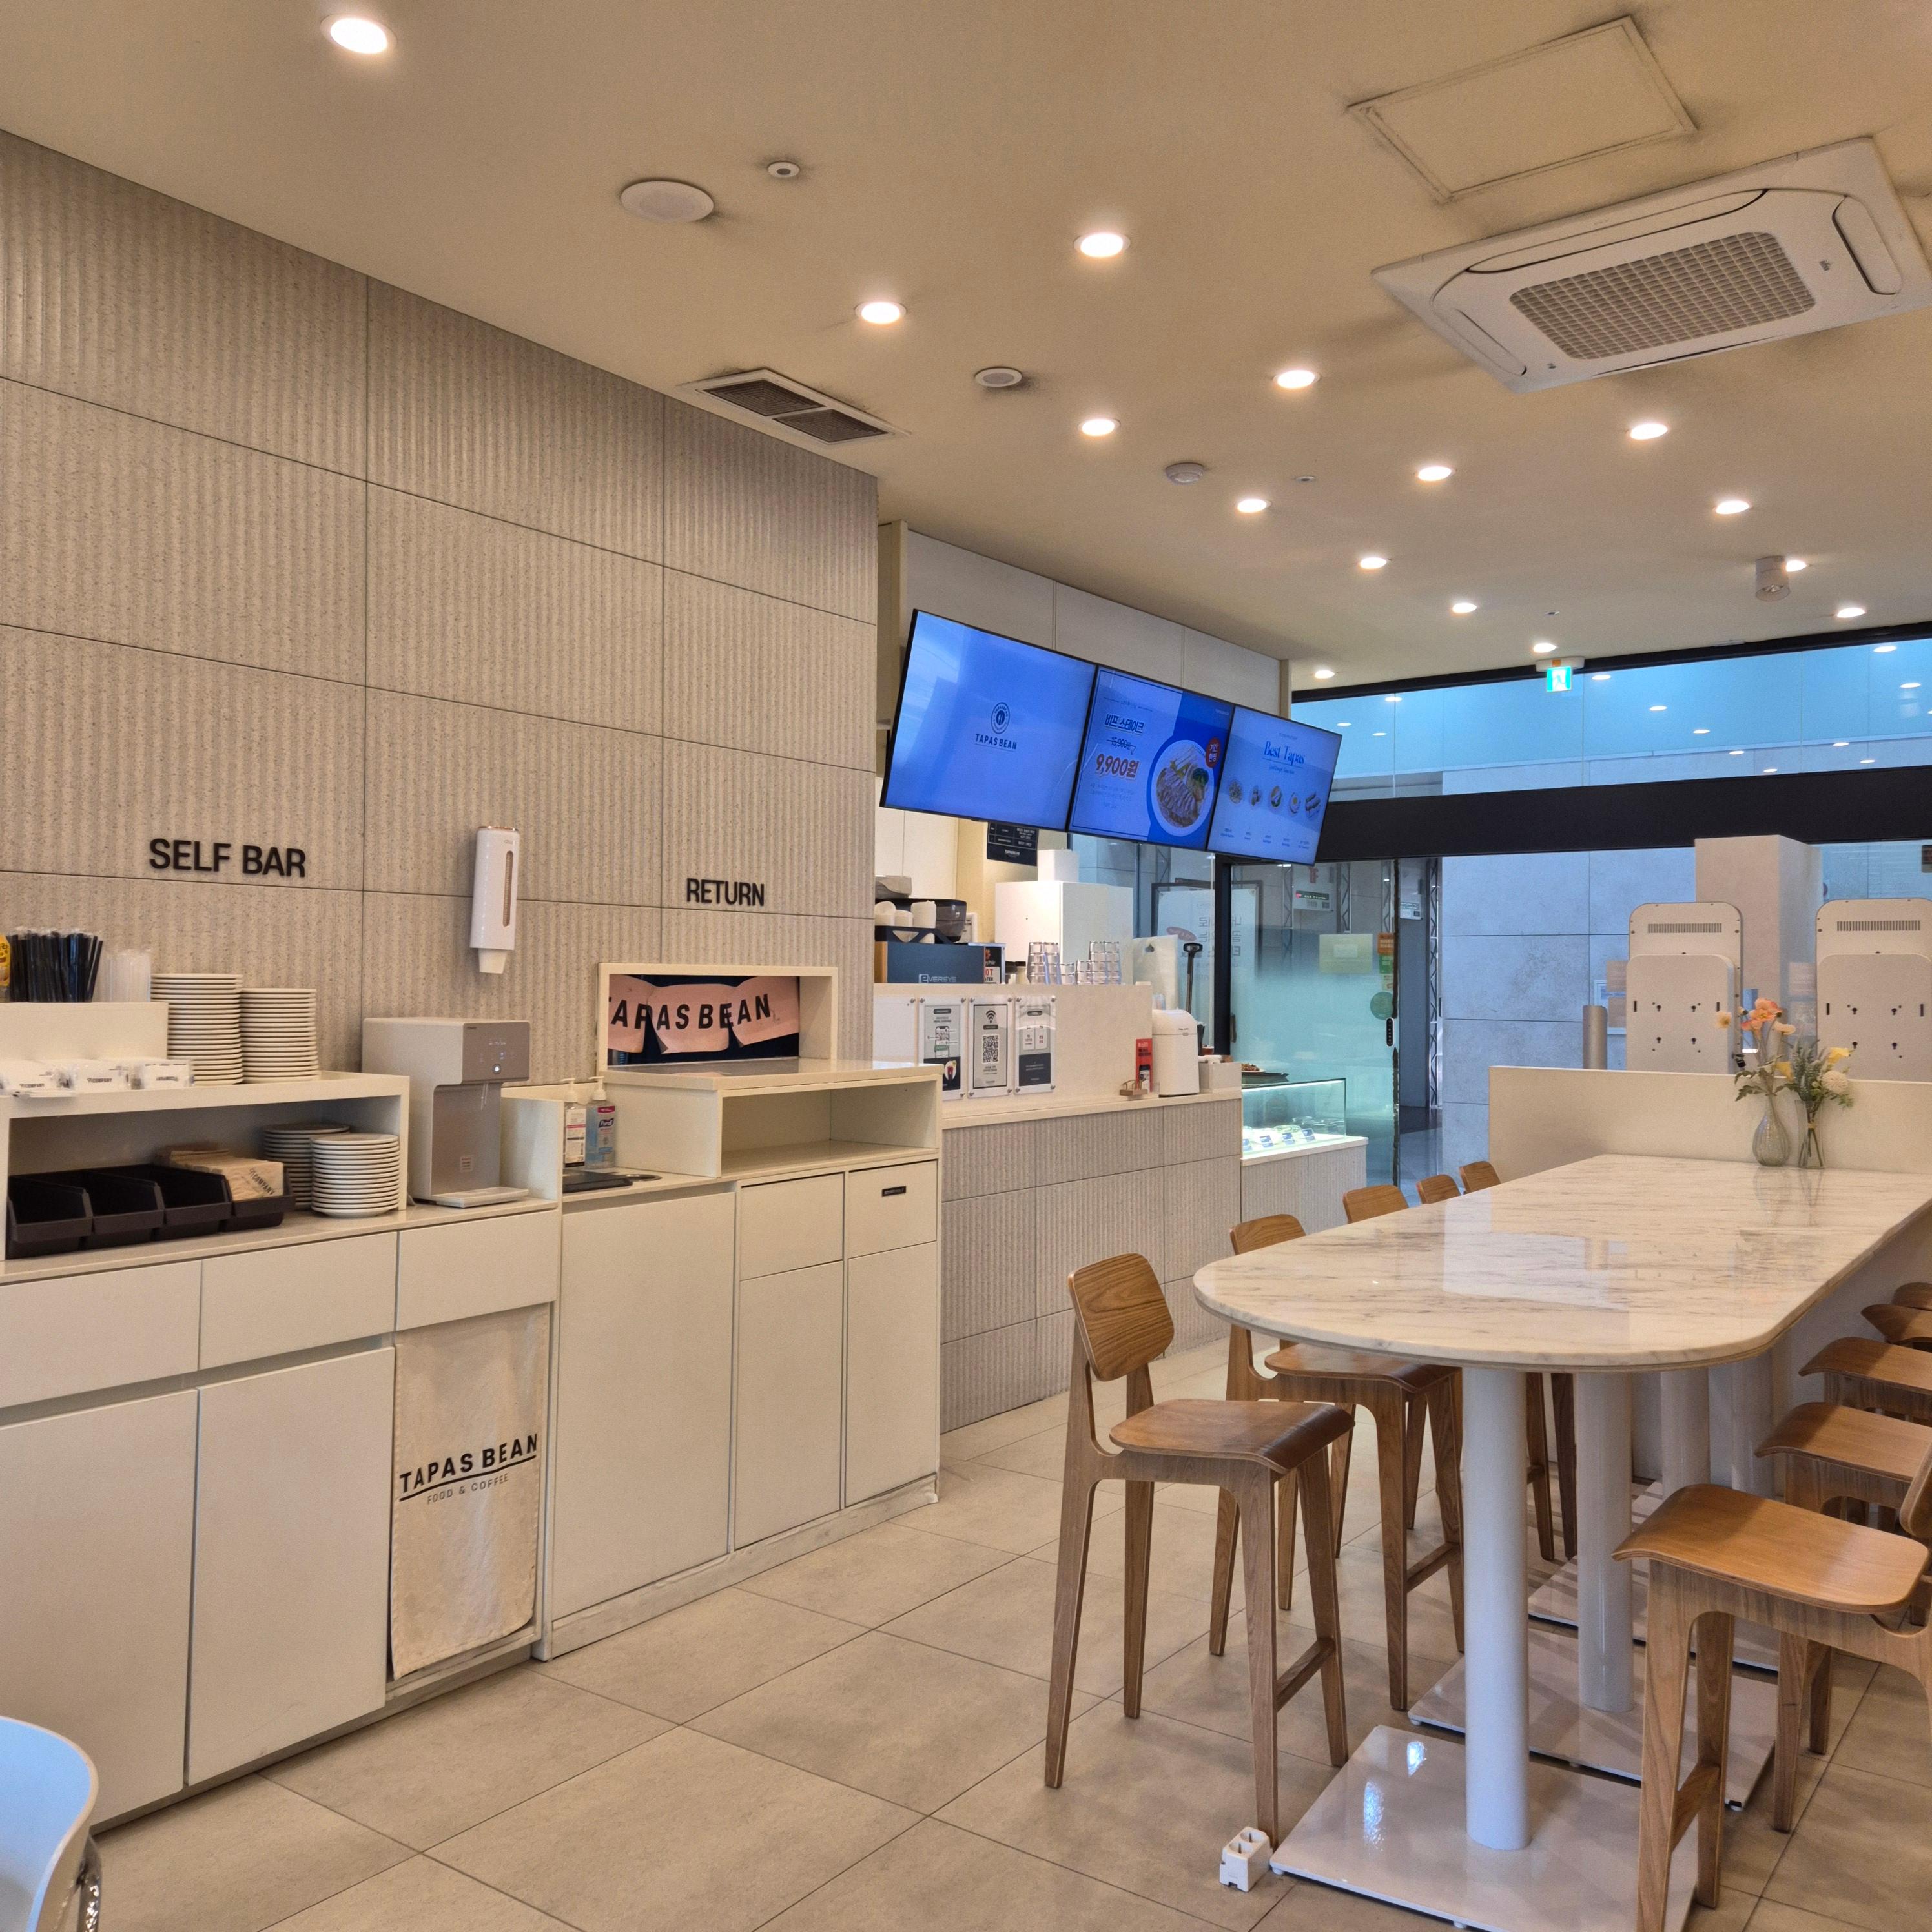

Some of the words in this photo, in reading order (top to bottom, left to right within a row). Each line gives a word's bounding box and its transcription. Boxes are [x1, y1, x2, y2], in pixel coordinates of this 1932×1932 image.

[1104, 714, 1119, 727] 비프
[1118, 717, 1144, 734] 스테이크
[975, 733, 998, 746] TAPAS
[998, 738, 1017, 750] BEAN
[1264, 740, 1282, 759] Best
[1284, 745, 1304, 766] Tapas
[1096, 754, 1140, 779] 9,900원
[149, 838, 231, 872] SELF
[242, 845, 305, 878] BAR
[686, 878, 765, 907] RETURN
[698, 993, 772, 1029] BEAN
[399, 1453, 473, 1494] TAPAS
[482, 1433, 538, 1469] BEAN
[427, 1488, 454, 1505] FOOD
[458, 1486, 466, 1495] &
[471, 1472, 509, 1492] COFFEE
